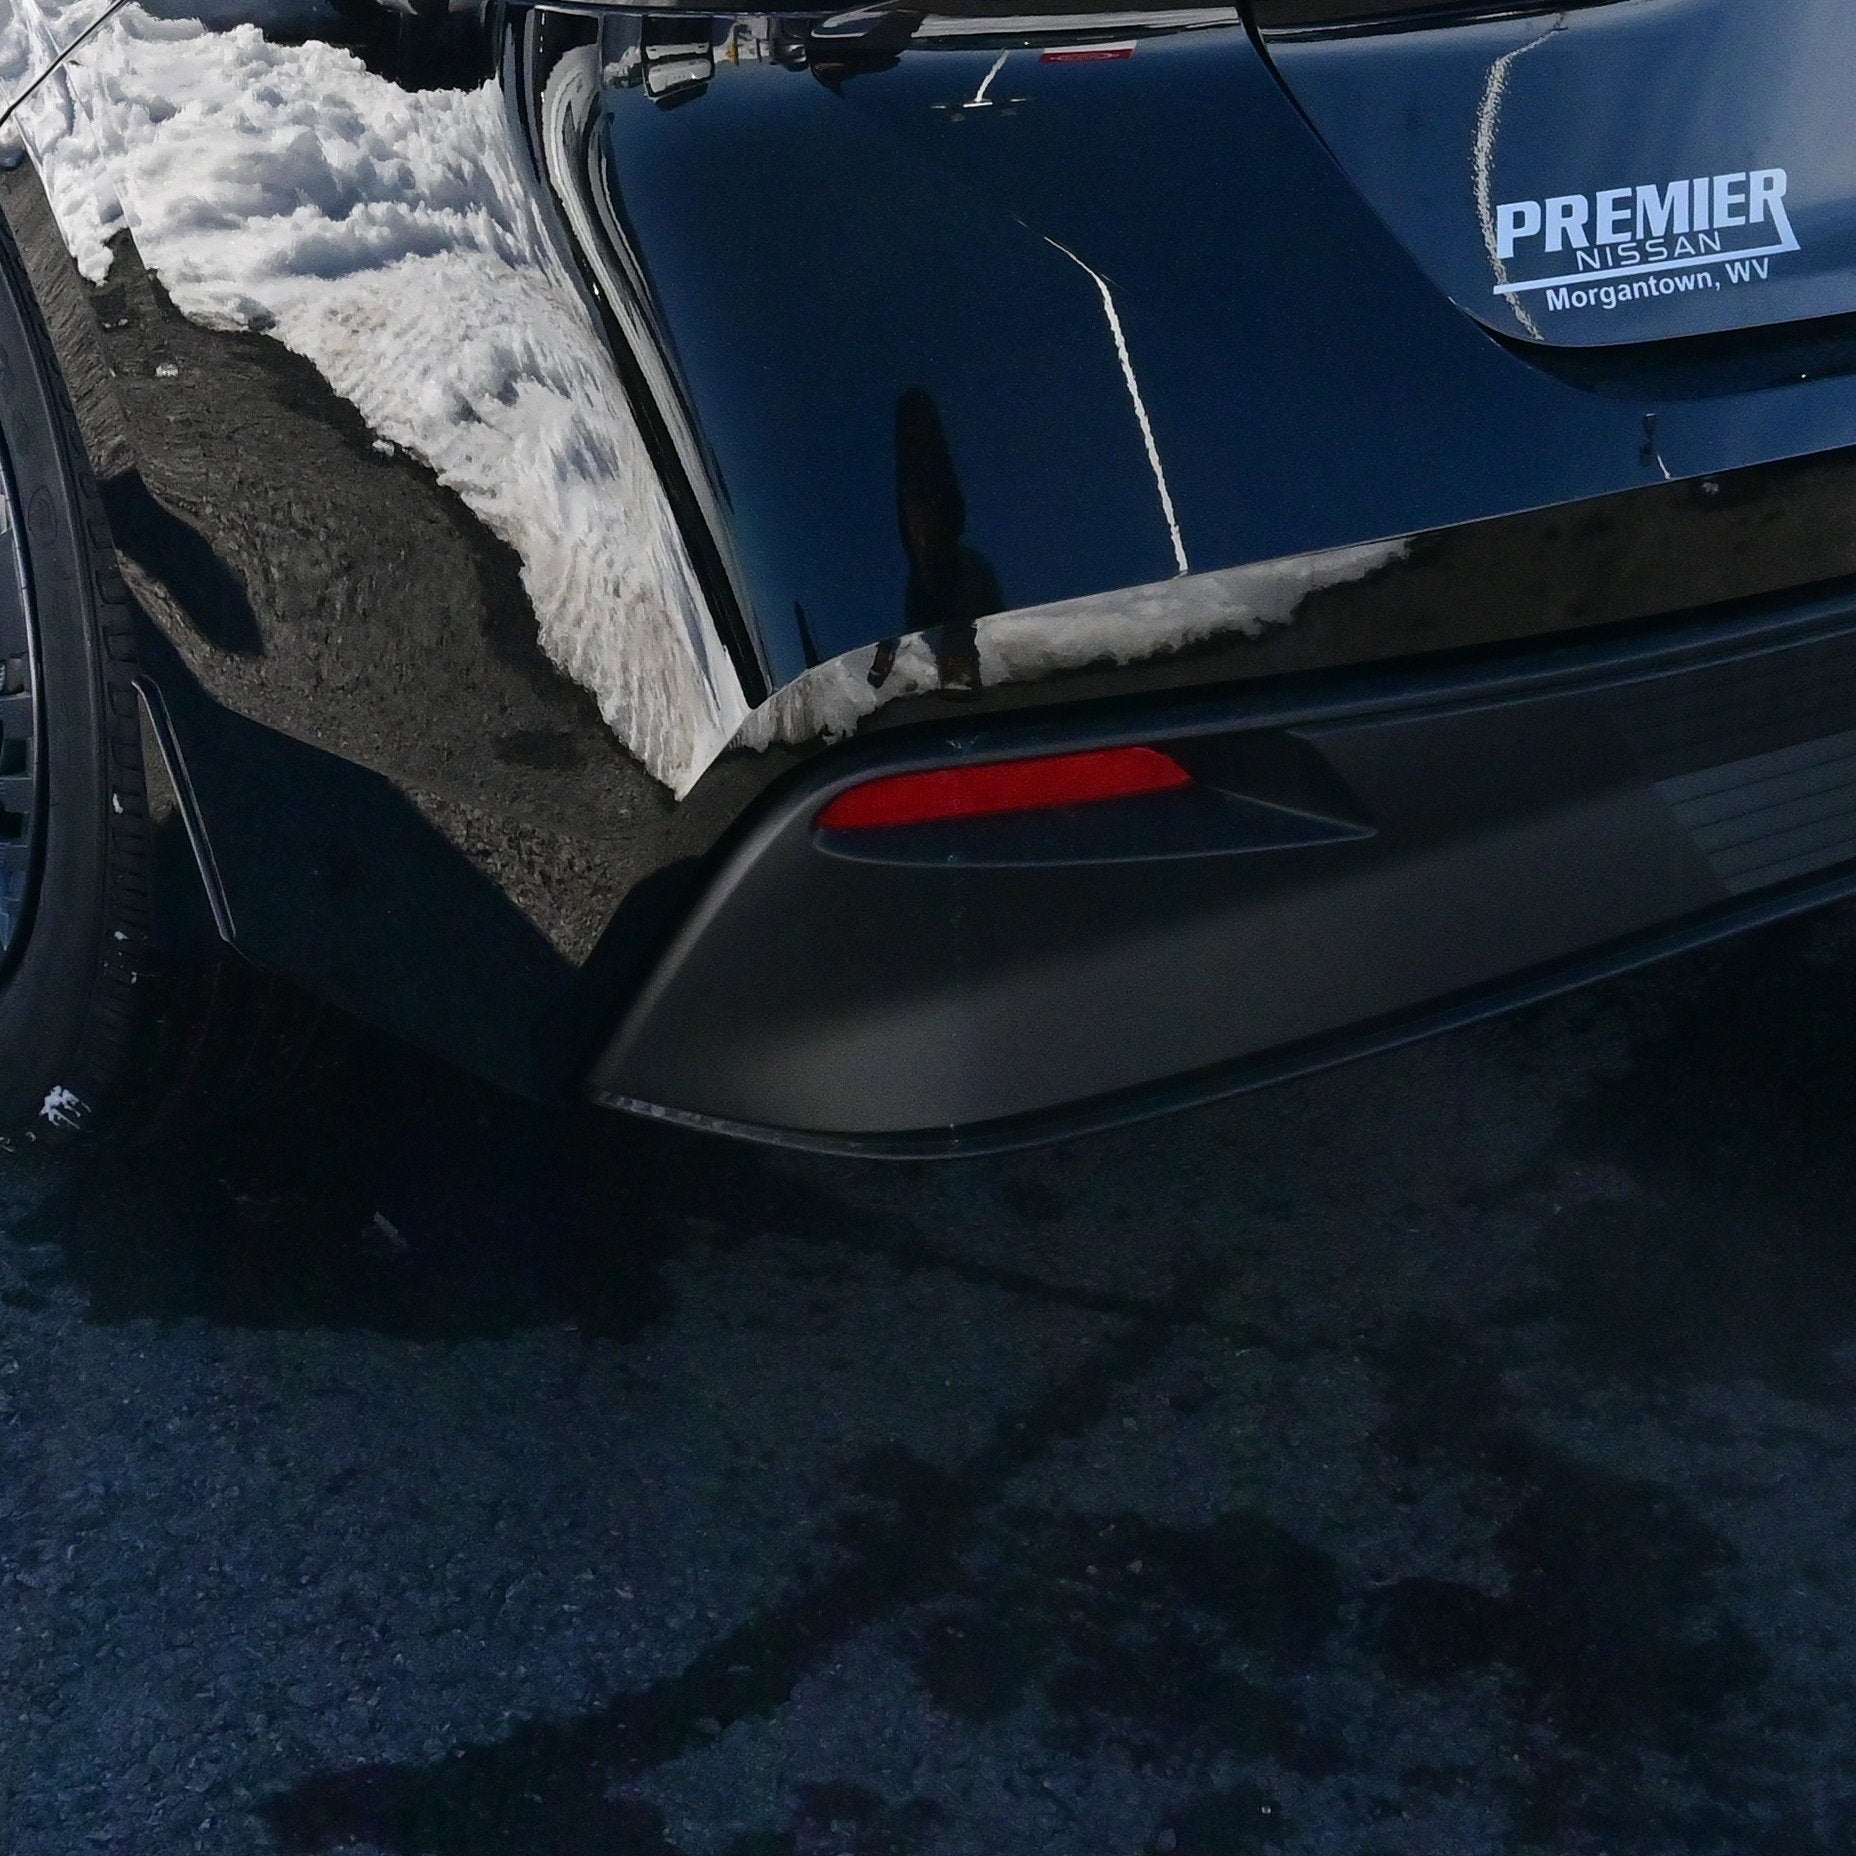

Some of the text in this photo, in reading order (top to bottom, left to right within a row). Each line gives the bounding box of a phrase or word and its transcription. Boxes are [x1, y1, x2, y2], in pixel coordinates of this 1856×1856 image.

[1495, 167, 1801, 260] PREMIER
[1576, 230, 1722, 272] NISSAN
[1545, 257, 1770, 312] Morgantown, WV
